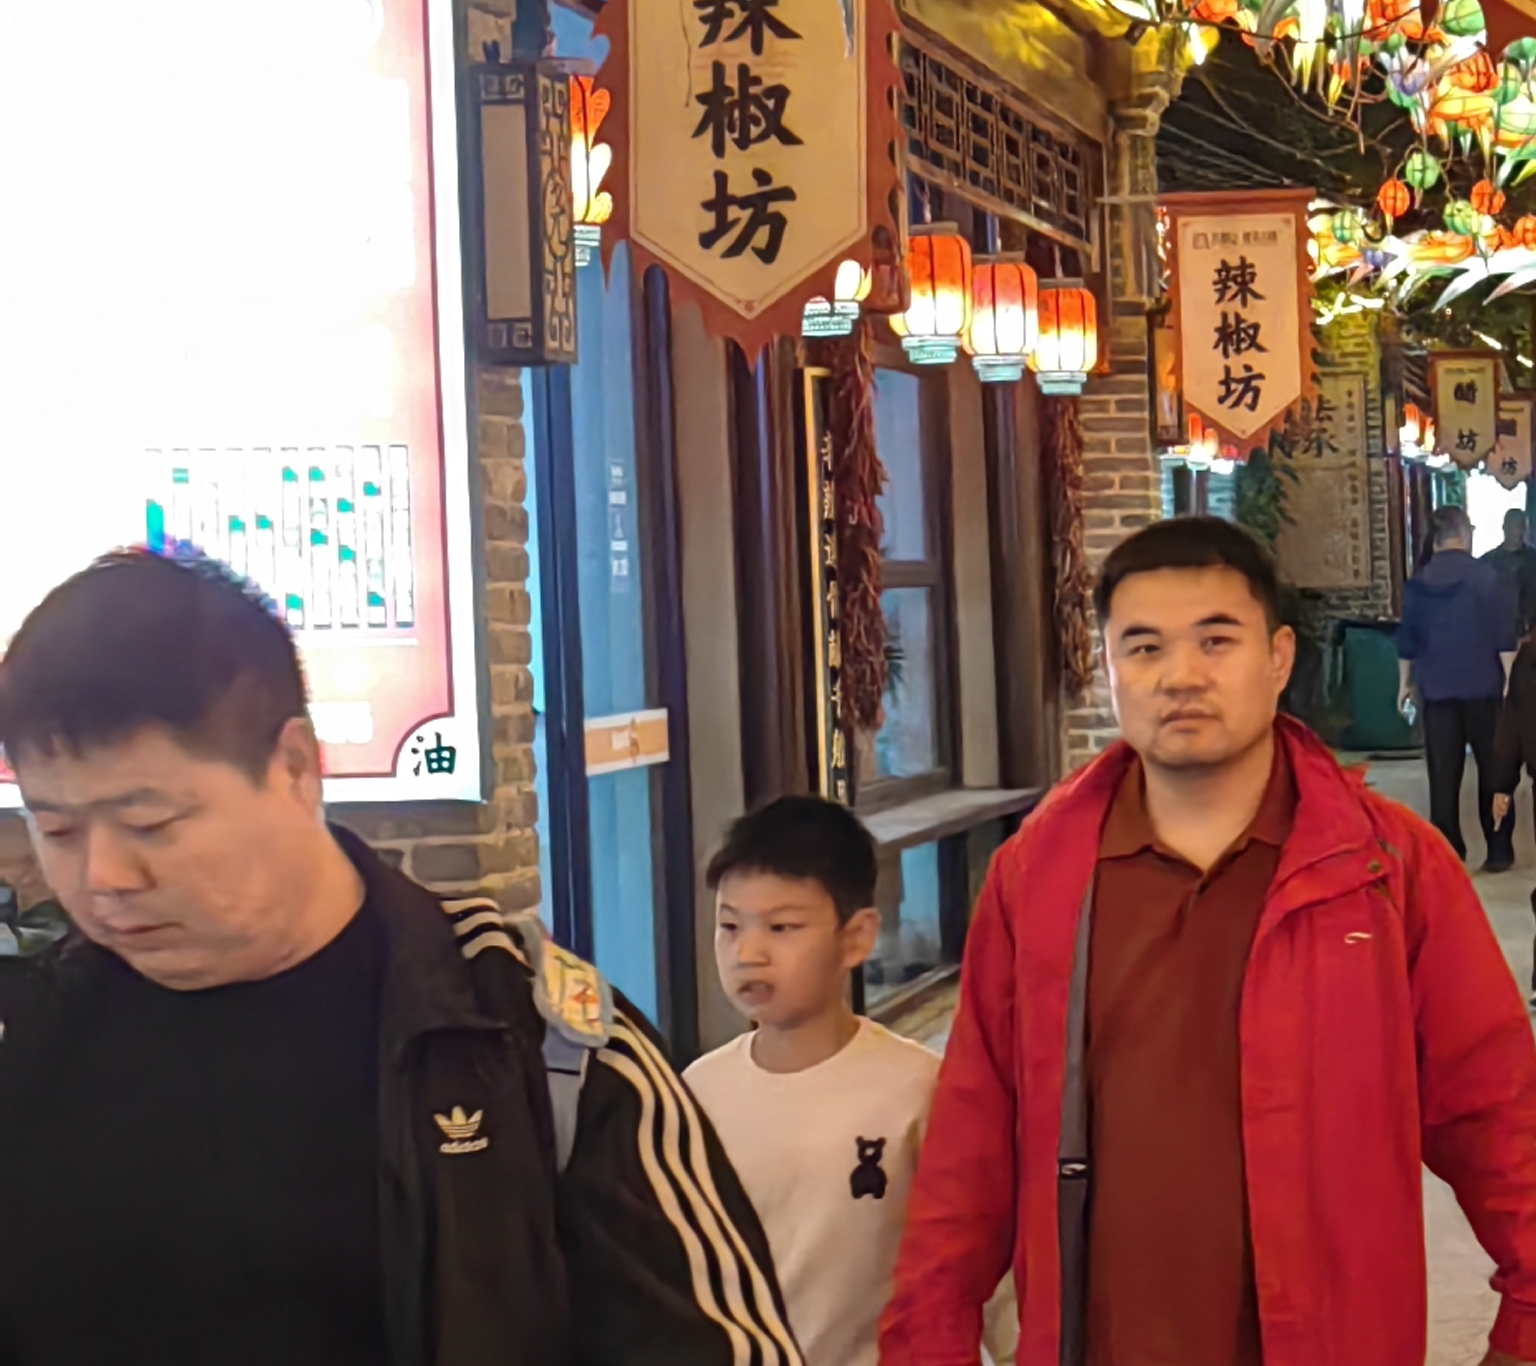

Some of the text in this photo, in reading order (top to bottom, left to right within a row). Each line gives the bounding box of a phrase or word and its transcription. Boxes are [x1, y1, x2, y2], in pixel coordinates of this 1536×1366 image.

[1211, 255, 1271, 413] 辣椒坊
[410, 733, 458, 778] 油
